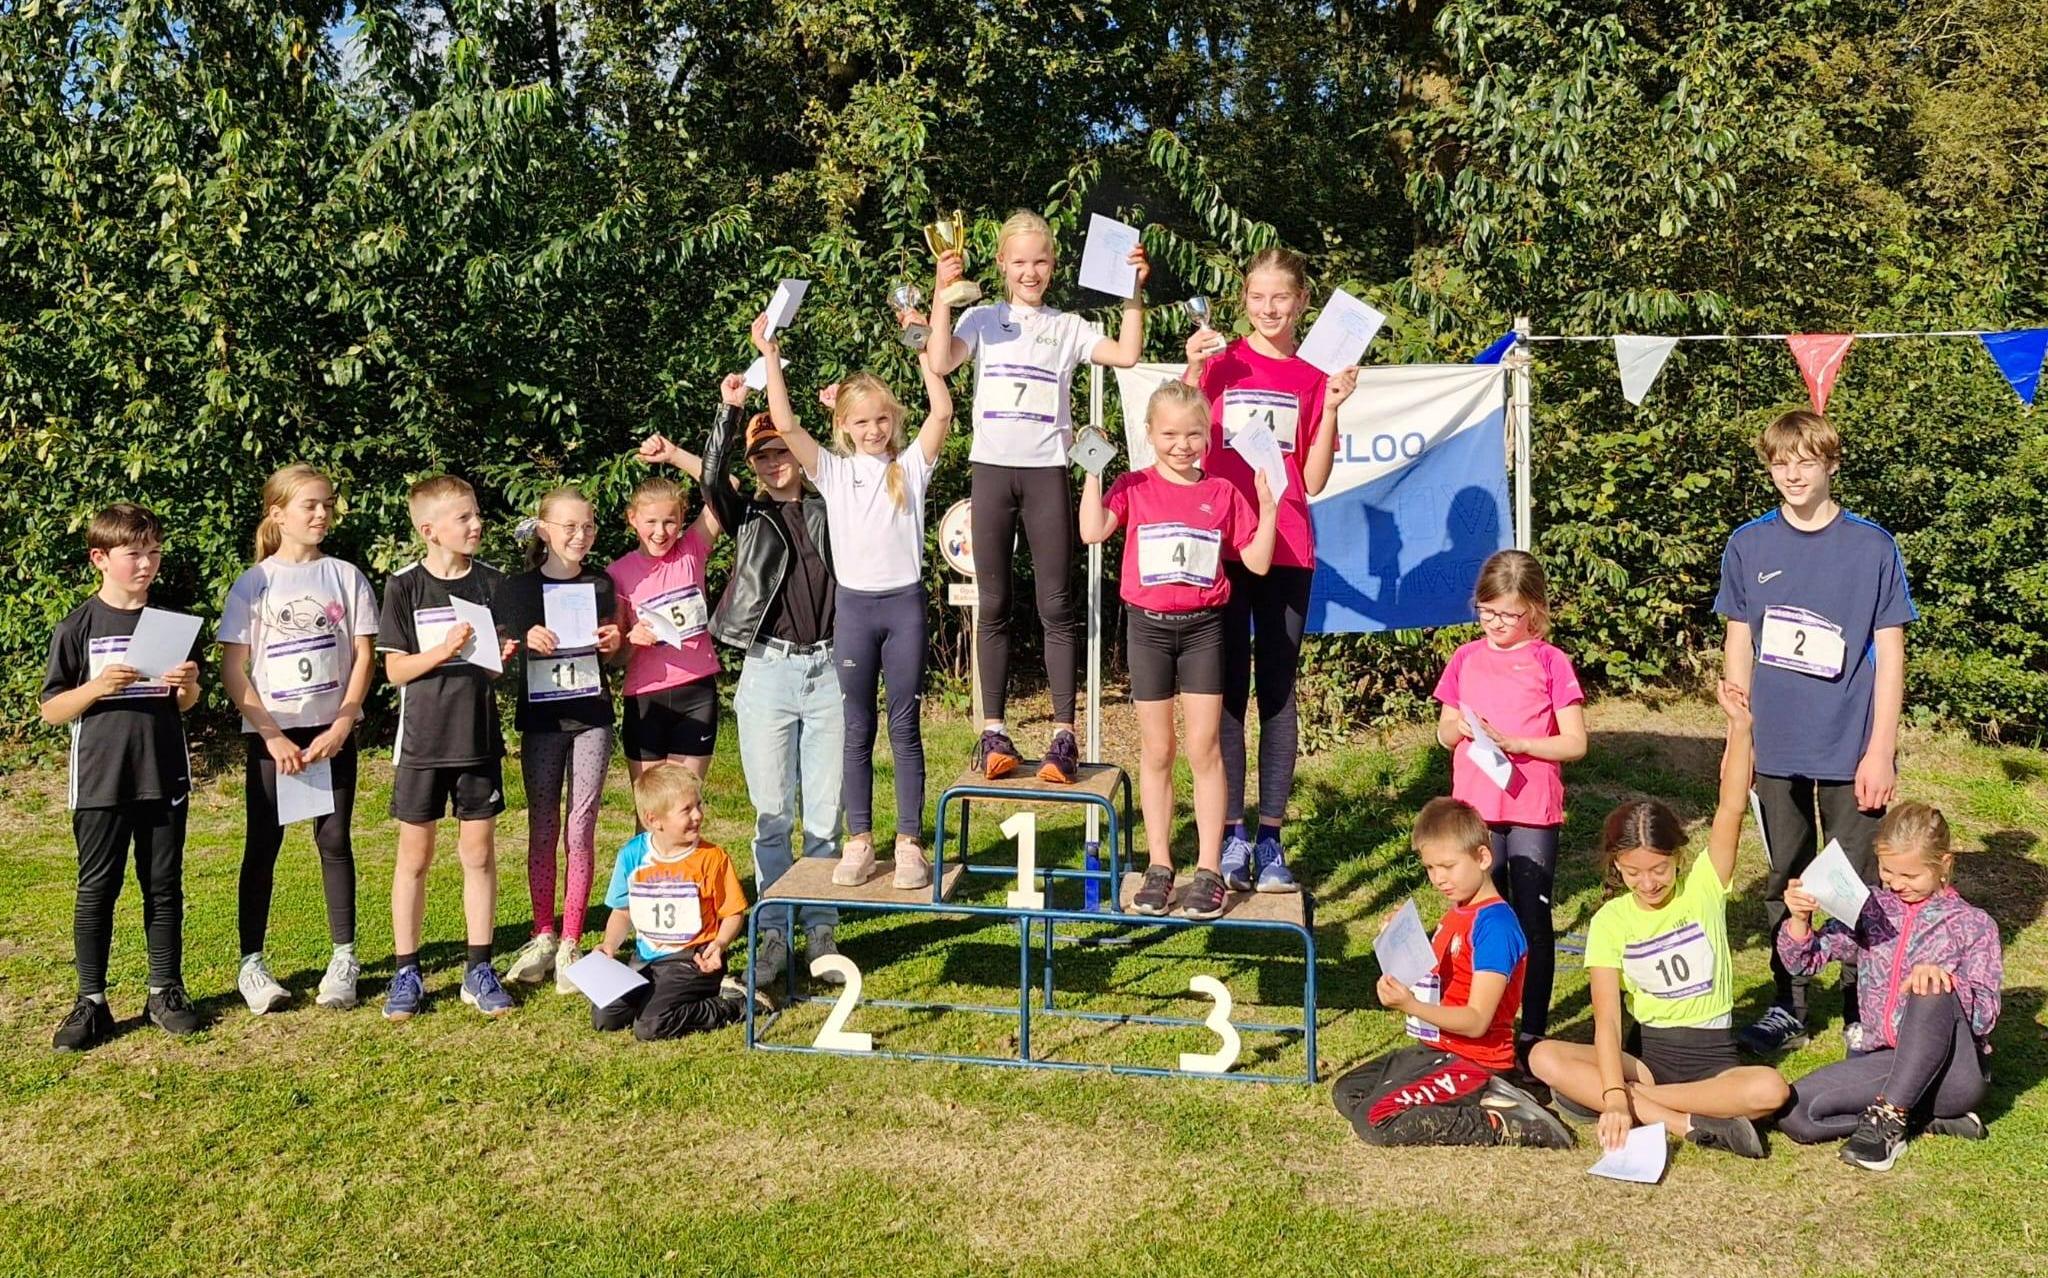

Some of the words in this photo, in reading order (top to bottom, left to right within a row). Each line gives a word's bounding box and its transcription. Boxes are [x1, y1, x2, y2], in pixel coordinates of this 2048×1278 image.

[1013, 382, 1027, 407] 7
[1172, 541, 1186, 567] 4
[670, 606, 686, 627] 5
[1793, 629, 1806, 656] 2
[298, 657, 313, 682] 9
[551, 662, 576, 688] 11
[1000, 812, 1045, 909] 1
[652, 903, 676, 929] 13
[1655, 953, 1690, 987] 10
[809, 954, 872, 1051] 2
[1179, 975, 1241, 1073] 3
